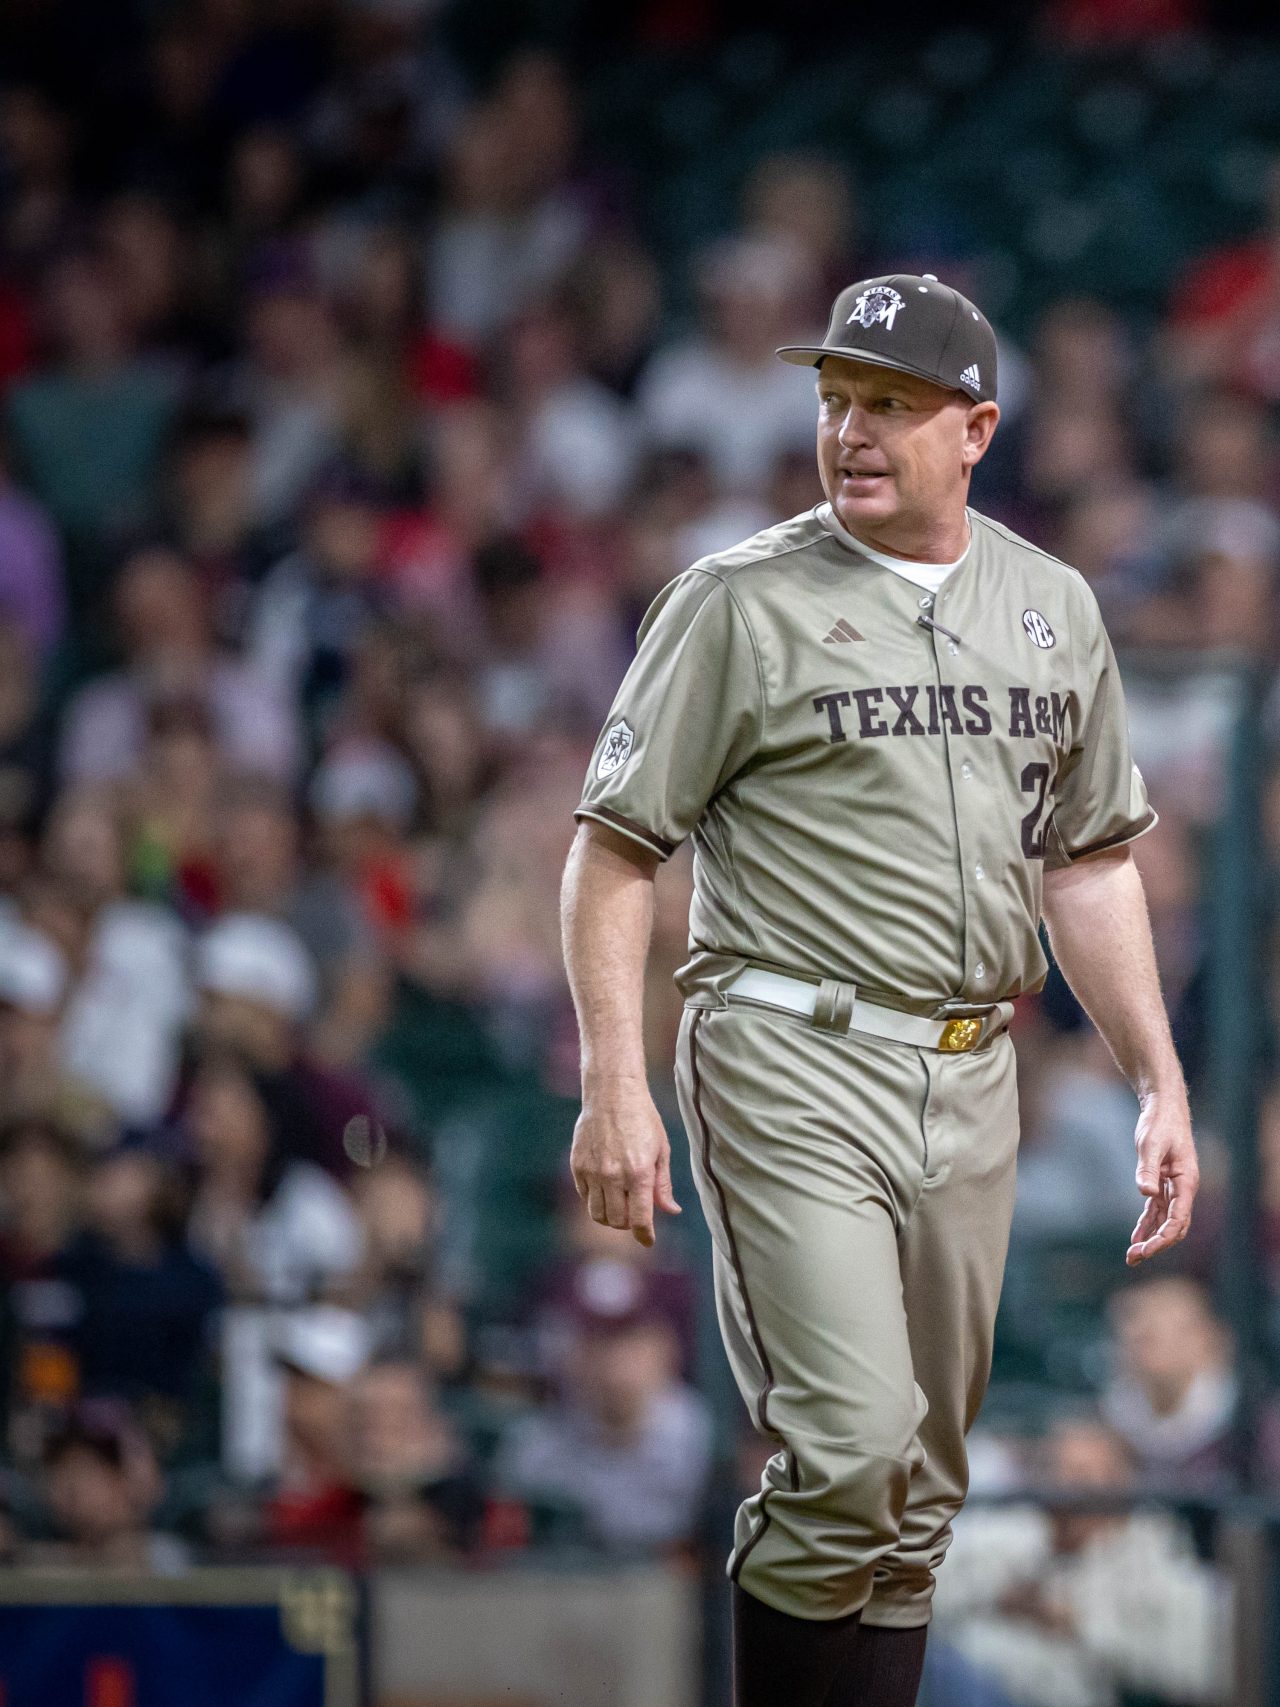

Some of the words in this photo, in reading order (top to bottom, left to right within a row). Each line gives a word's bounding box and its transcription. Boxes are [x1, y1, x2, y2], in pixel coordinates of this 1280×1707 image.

[1023, 610, 1054, 648] SEC
[813, 685, 992, 744] TEXAS
[1008, 687, 1070, 747] A&M
[1021, 762, 1056, 860] 2
